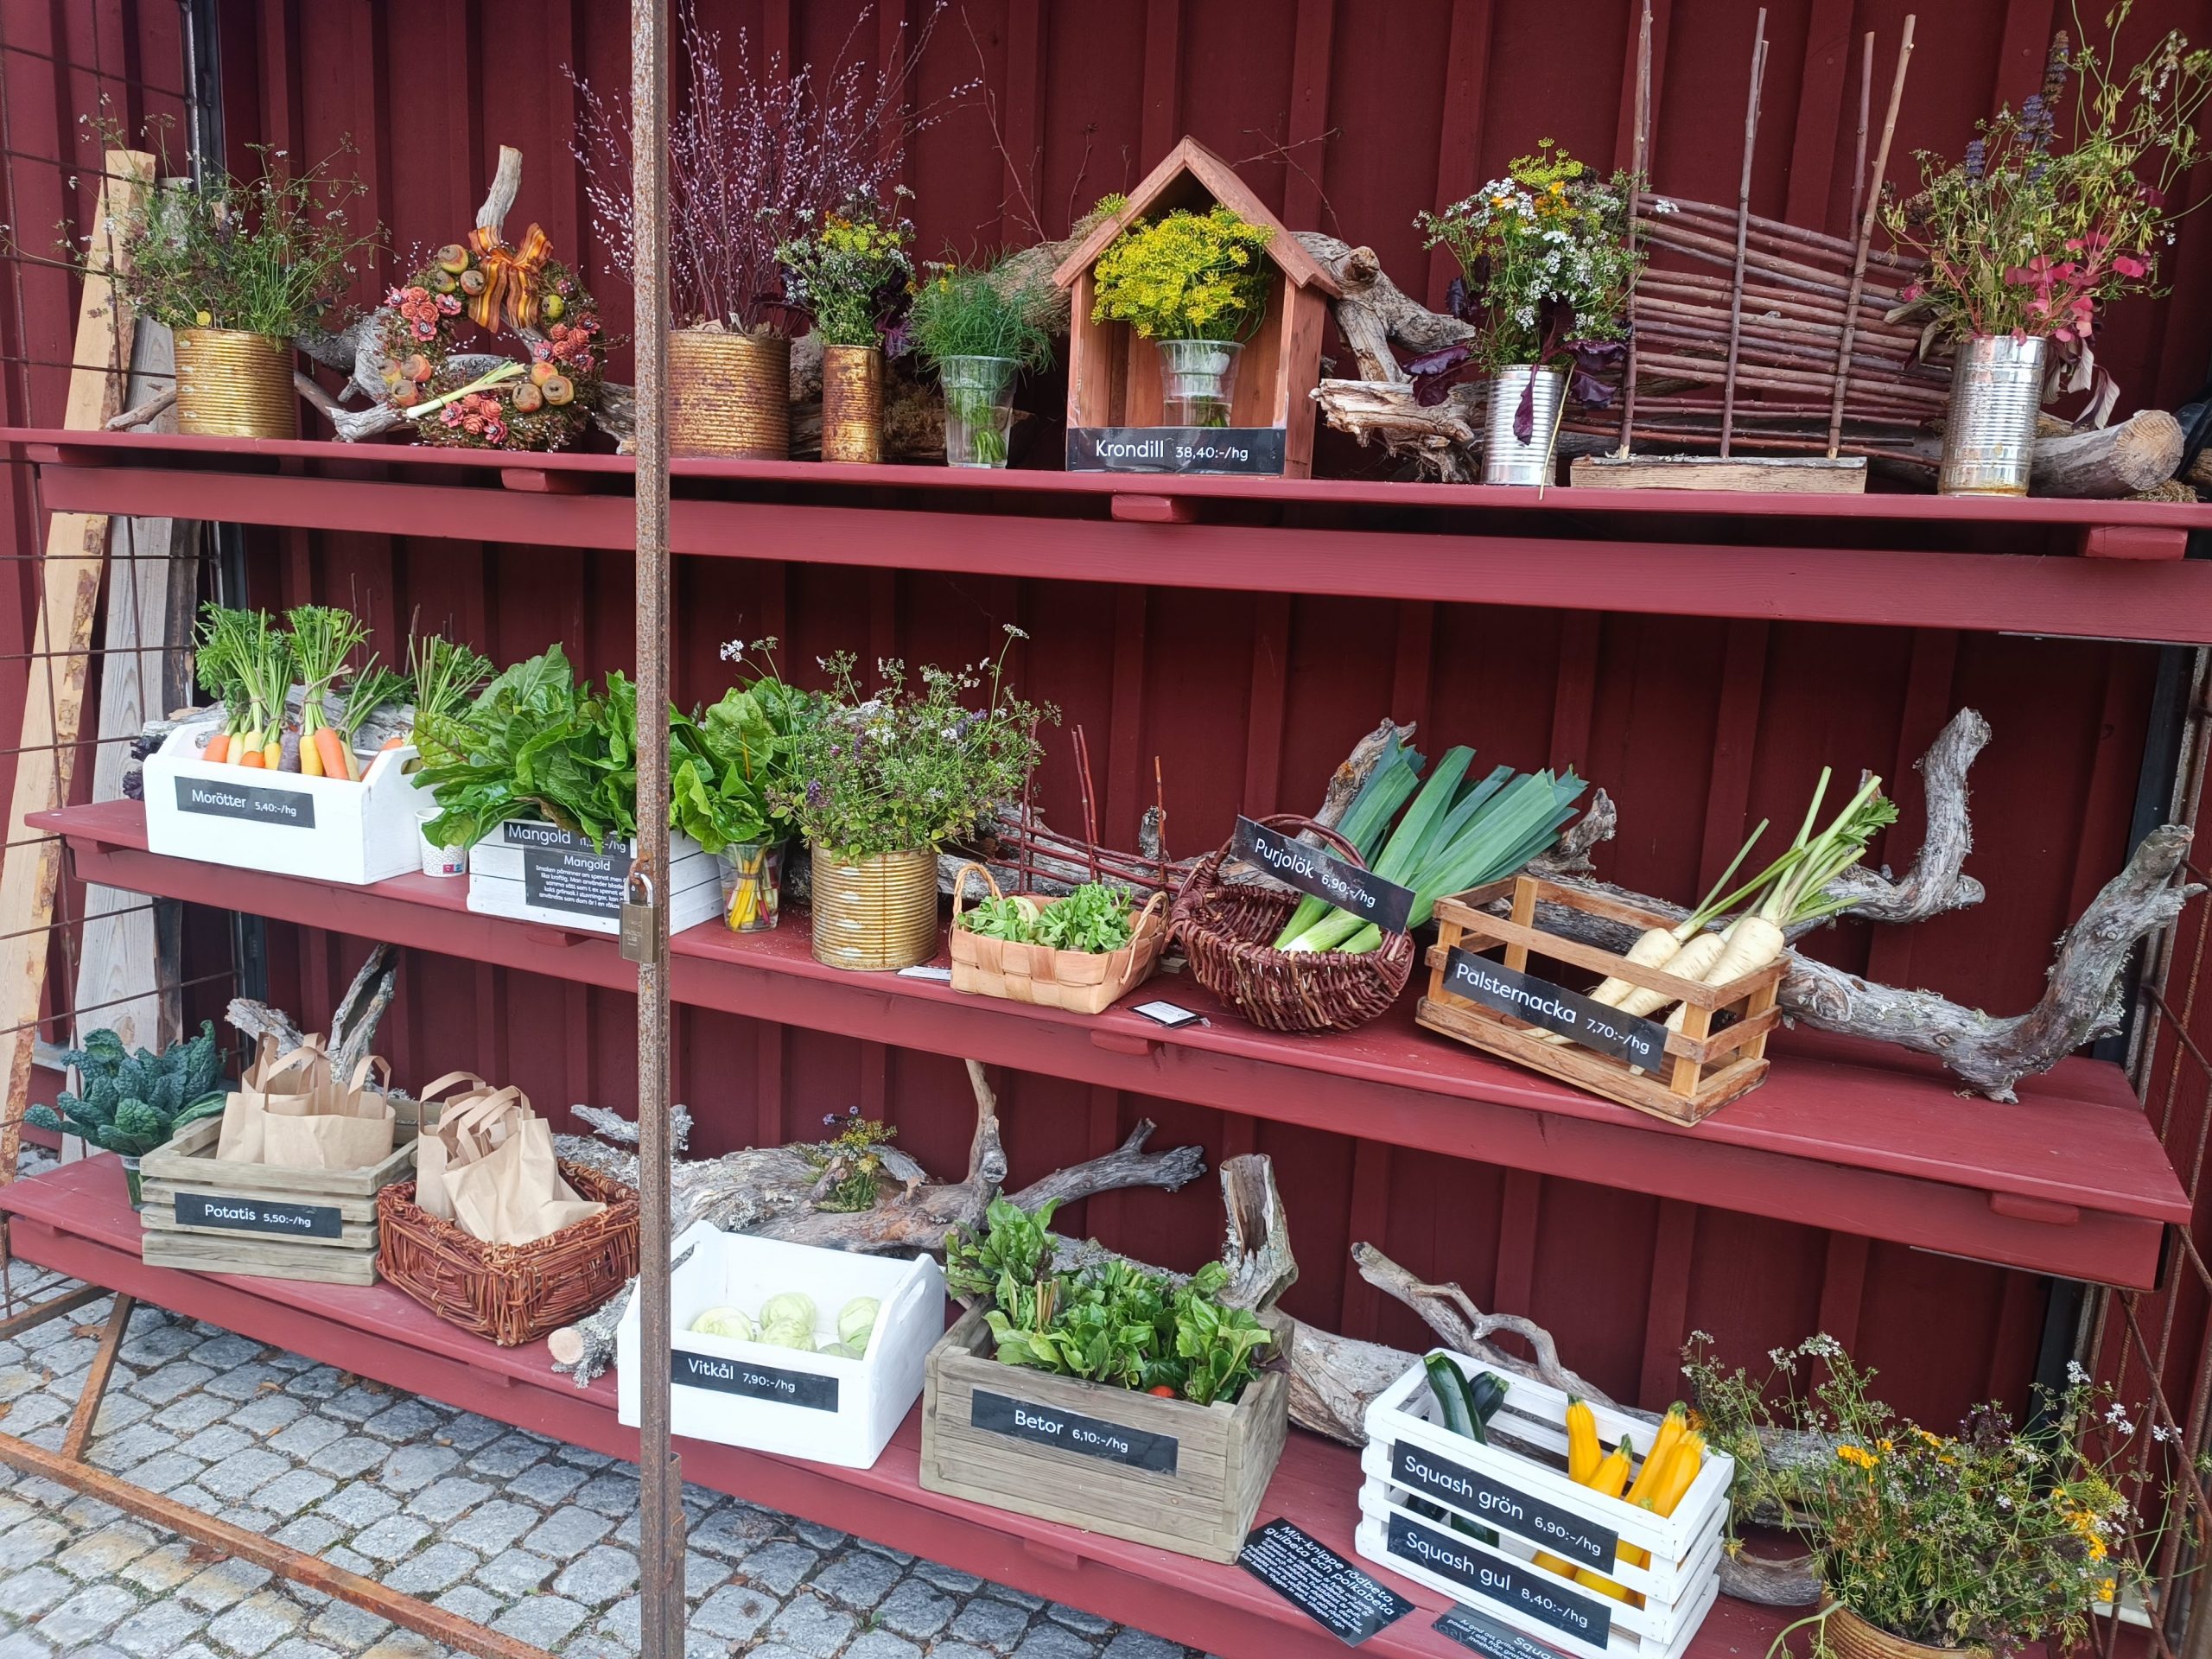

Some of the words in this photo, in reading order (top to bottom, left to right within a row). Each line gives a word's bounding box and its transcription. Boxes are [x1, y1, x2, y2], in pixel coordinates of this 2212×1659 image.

[1096, 440, 1164, 458] Krondill
[1175, 446, 1249, 461] 38,40:-/hg
[192, 789, 247, 809] Morötter
[255, 801, 297, 817] 5,40:-/hg
[508, 823, 571, 845] Mangold
[563, 855, 611, 871] Mangold
[1255, 838, 1315, 879] Purjolök
[1321, 874, 1376, 908] 6,90:-/hg
[1456, 963, 1577, 1024] Palsternacka
[1586, 1018, 1650, 1055] 7,70:-/hg
[205, 1205, 256, 1221] Potatis
[263, 1213, 312, 1228] 5,50:-/hg
[688, 1357, 734, 1380] Vitkål
[742, 1373, 796, 1393] 7,90:-/hg
[1014, 1409, 1064, 1436] Betor
[1072, 1429, 1128, 1453] 6,10:-/hg
[1404, 1455, 1473, 1498] Squash
[1478, 1491, 1523, 1520] grön
[1535, 1516, 1601, 1556] 6,90:-/hg
[1264, 1528, 1311, 1557] gulbeta
[1311, 1556, 1332, 1573] och
[1331, 1573, 1395, 1615] polkabeta
[1281, 1527, 1344, 1569] Mix-knippe
[1344, 1570, 1393, 1605] rödbeta,
[1406, 1532, 1474, 1576] Squash
[1480, 1568, 1510, 1591] gul
[1521, 1587, 1588, 1628] 8,40:-/hg
[1446, 1618, 1471, 1633] passar
[1475, 1633, 1488, 1643] allt
[1488, 1639, 1503, 1650] från
[1469, 1624, 1485, 1633] god
[1484, 1632, 1496, 1641] att
[1514, 1637, 1555, 1659] Squa
